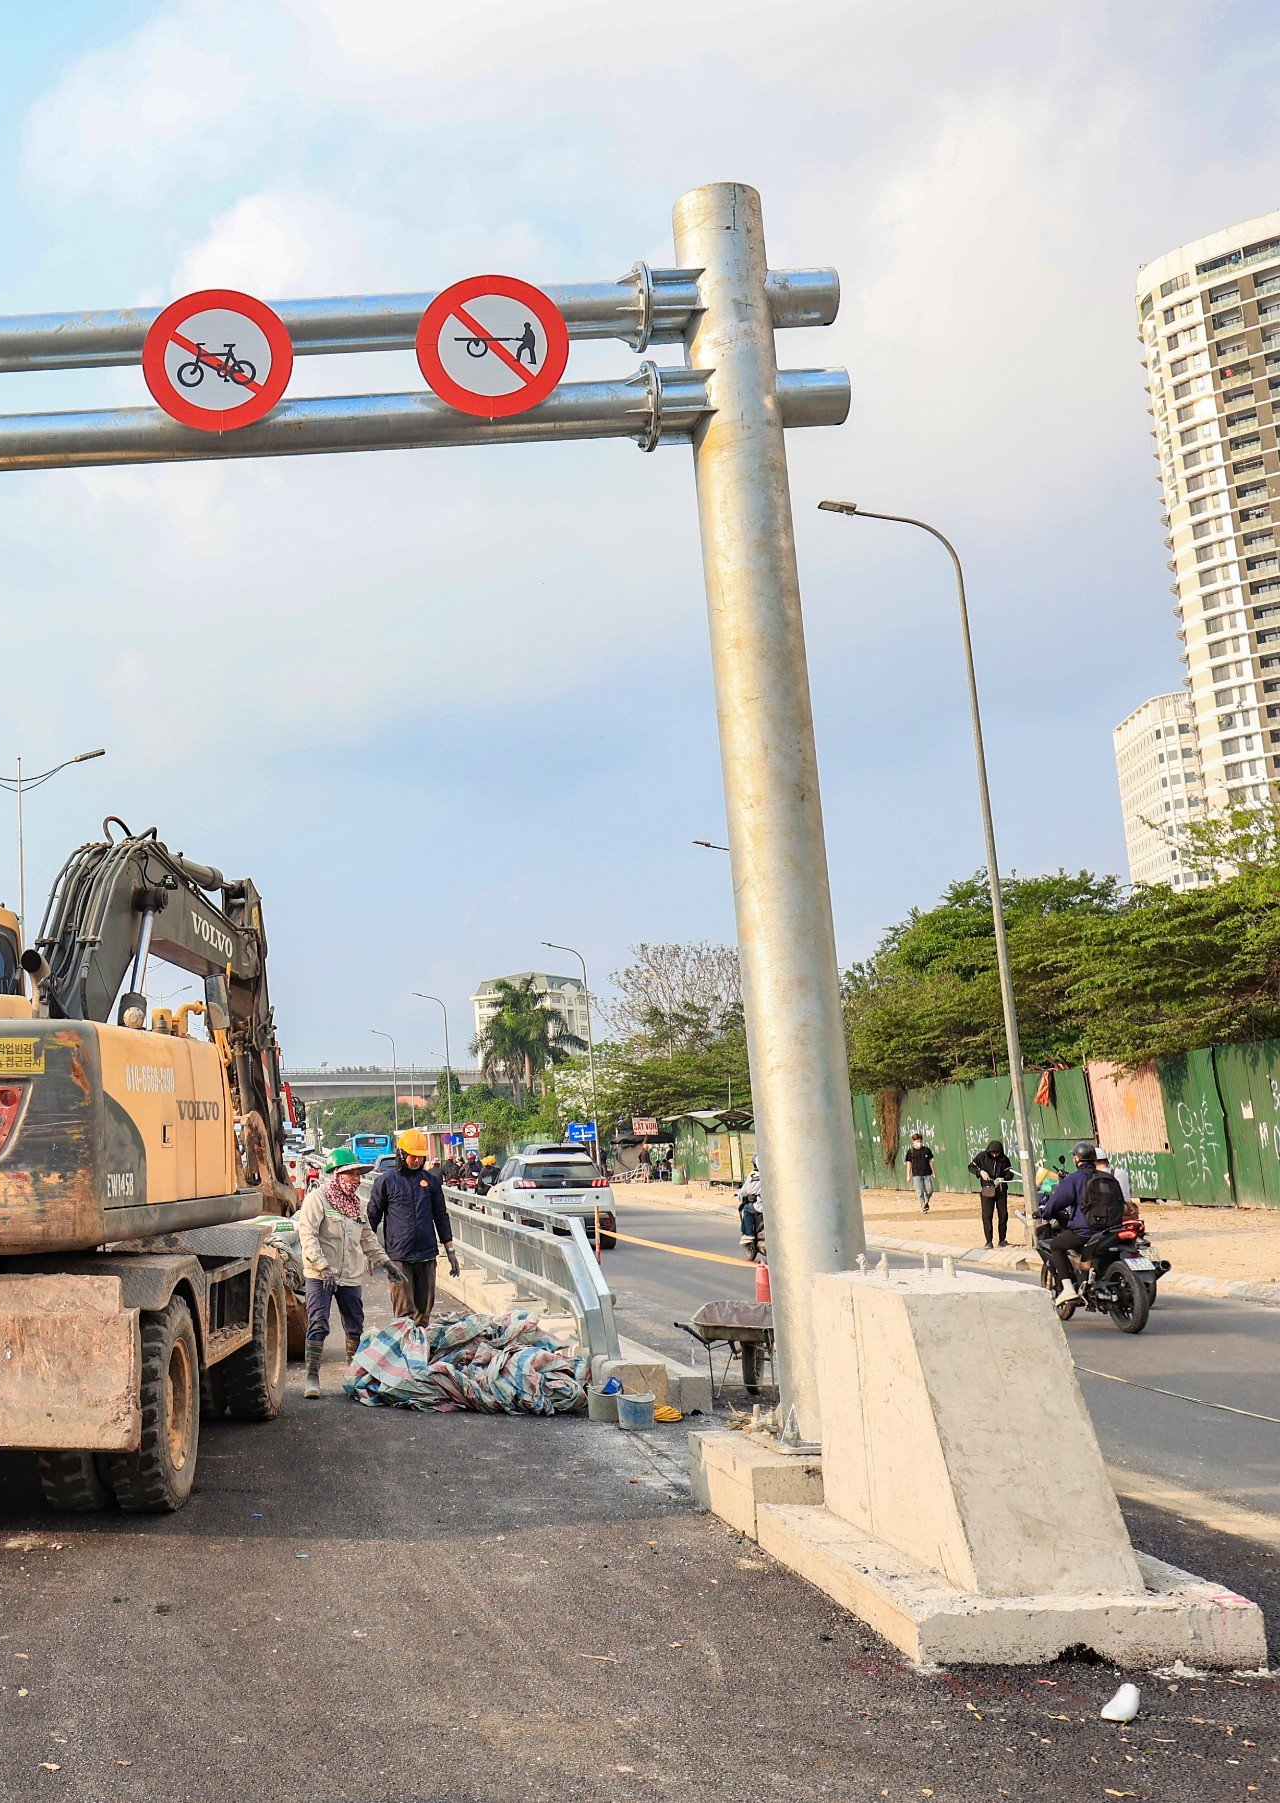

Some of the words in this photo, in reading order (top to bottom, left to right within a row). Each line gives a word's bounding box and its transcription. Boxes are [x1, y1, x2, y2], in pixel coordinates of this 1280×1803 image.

[190, 910, 233, 959] VOLVO
[176, 1100, 220, 1121] VOLVO
[107, 1173, 134, 1198] EW145B
